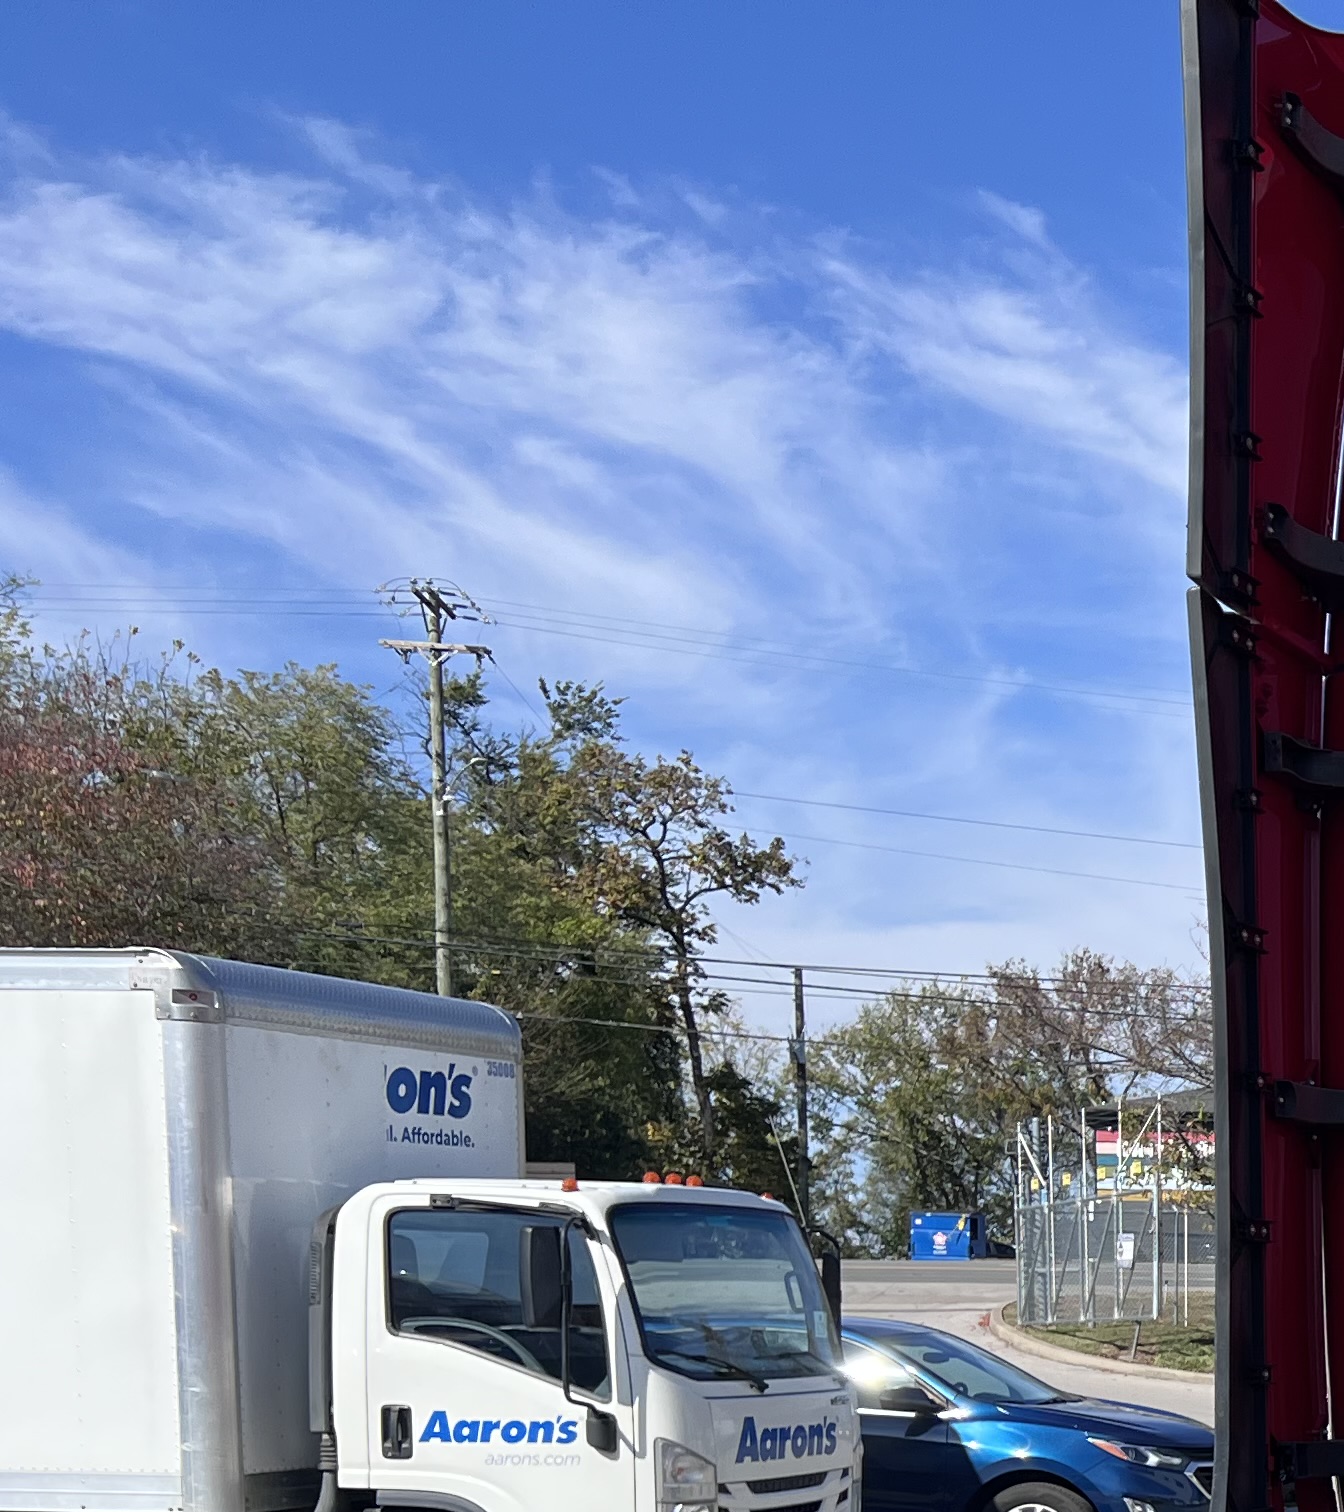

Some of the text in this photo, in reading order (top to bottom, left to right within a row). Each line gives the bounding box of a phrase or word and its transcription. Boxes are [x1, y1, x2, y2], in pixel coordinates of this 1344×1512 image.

[384, 1063, 472, 1119] on's
[401, 1126, 475, 1148] Affordable.
[418, 1410, 579, 1444] Aaron's
[735, 1416, 838, 1464] Aaron's
[485, 1453, 581, 1466] aarons.com
